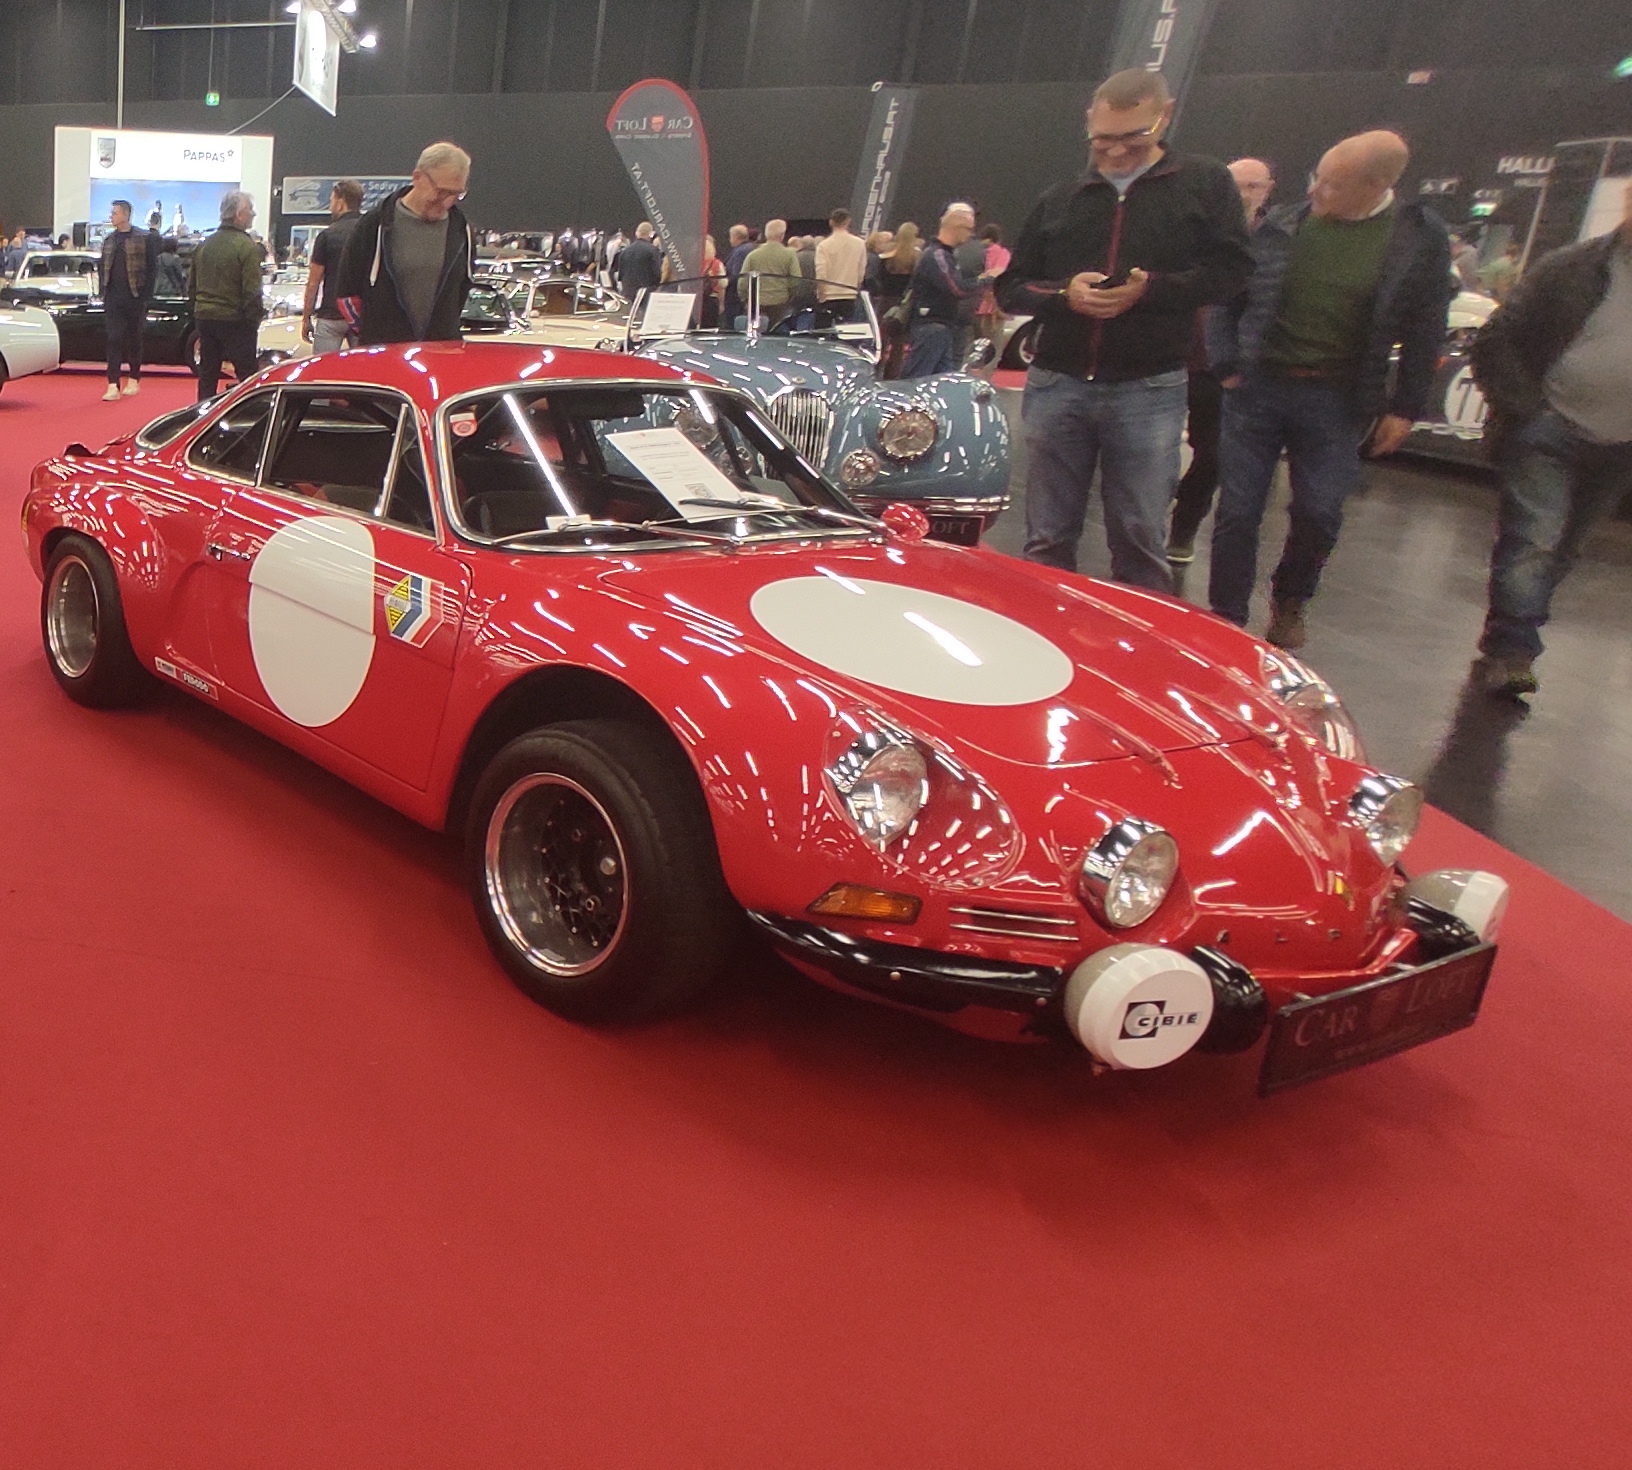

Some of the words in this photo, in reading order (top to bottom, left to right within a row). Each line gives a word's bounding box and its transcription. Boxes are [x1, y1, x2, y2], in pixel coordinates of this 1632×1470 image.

[183, 149, 226, 163] PAPPAS
[932, 520, 970, 535] OFT
[1294, 1006, 1359, 1047] CAR
